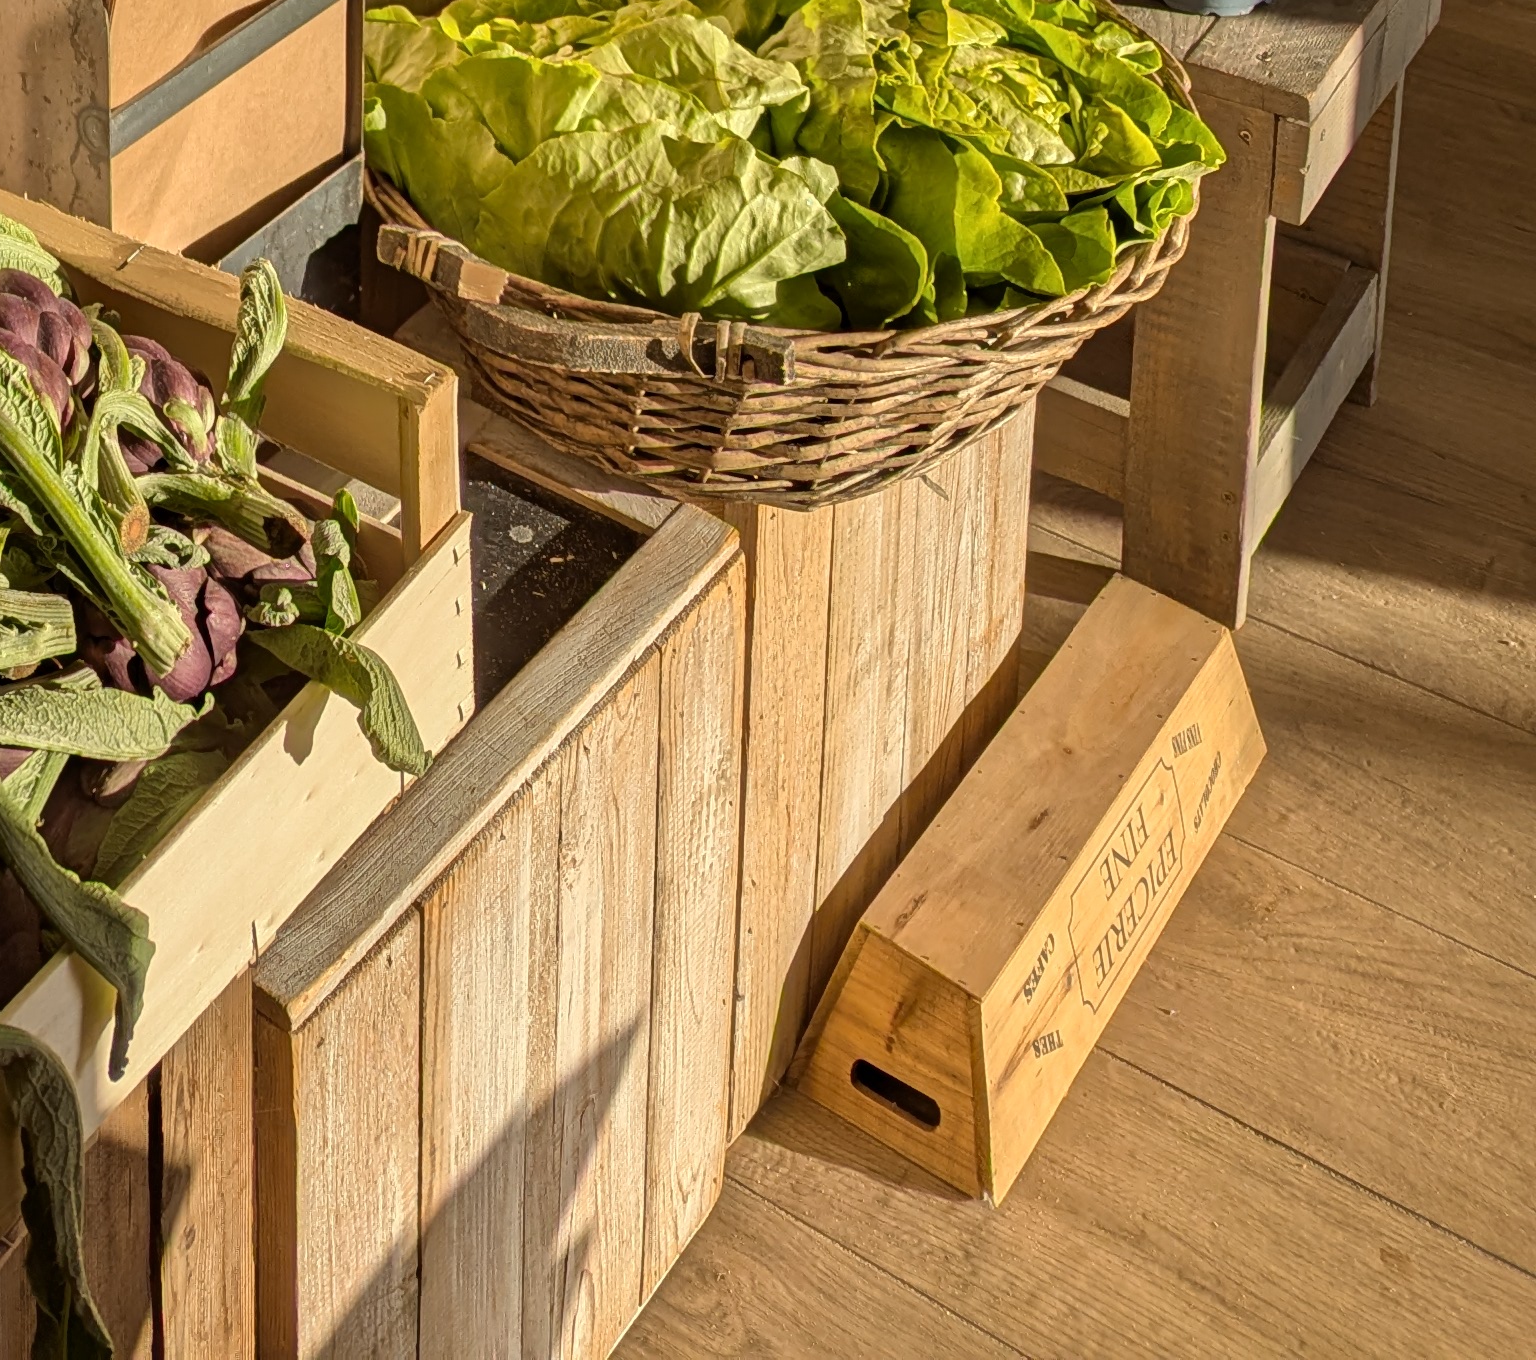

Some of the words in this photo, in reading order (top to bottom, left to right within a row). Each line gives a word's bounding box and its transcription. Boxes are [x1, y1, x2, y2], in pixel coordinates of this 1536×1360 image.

[1099, 802, 1151, 901] FINE
[1092, 827, 1179, 989] EPICERIE
[1023, 932, 1056, 1005] CAFES
[1031, 1029, 1065, 1060] THES
